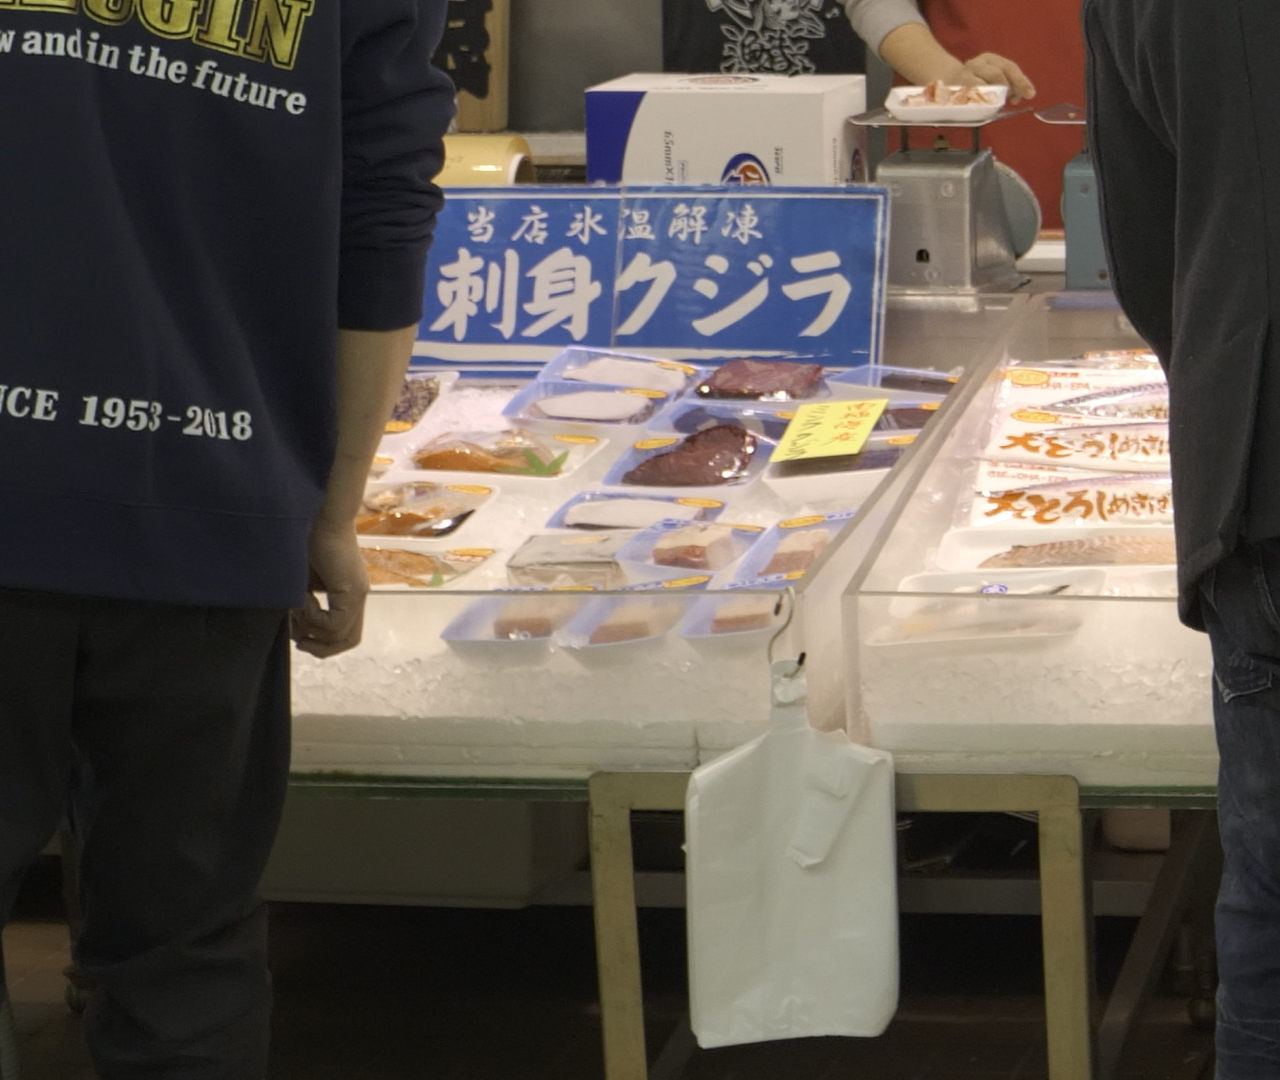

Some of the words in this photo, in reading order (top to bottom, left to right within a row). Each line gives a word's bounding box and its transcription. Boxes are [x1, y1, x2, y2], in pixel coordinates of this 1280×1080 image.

[128, 45, 188, 85] the
[192, 60, 307, 116] future
[467, 204, 764, 246] 当店氷温解凍
[429, 246, 852, 343] 刺身クジラ
